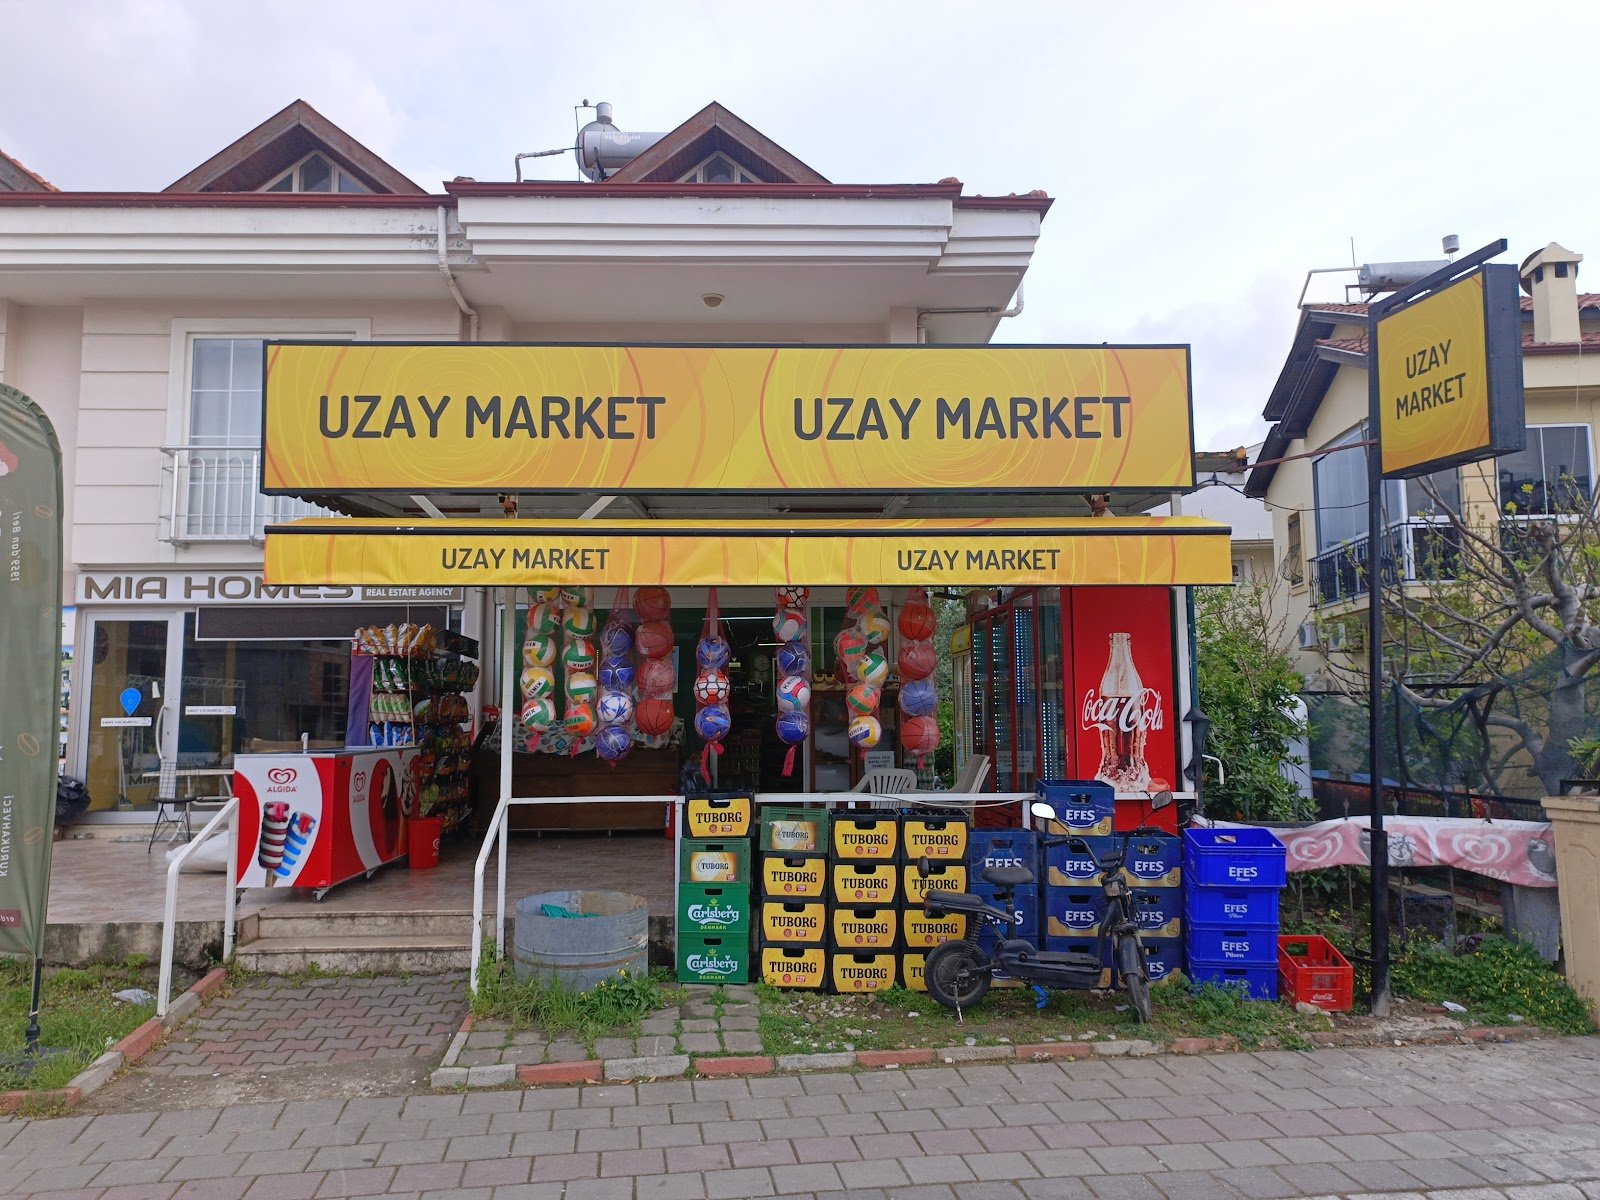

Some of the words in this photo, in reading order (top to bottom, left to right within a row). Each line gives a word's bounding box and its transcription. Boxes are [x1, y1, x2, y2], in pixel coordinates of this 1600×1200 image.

[1406, 339, 1451, 379] UZAY
[1396, 372, 1466, 420] MARKET
[319, 395, 451, 439] UZAY
[465, 395, 666, 440] MARKET
[794, 397, 921, 441] UZAY
[936, 396, 1131, 440] MARKET
[442, 547, 506, 569] UZAY
[512, 547, 610, 570] MARKET
[897, 549, 959, 571] UZAY
[966, 549, 1060, 570] MARKET
[85, 576, 167, 600] MIA
[366, 588, 386, 597] REAL
[388, 588, 416, 597] ESTATE
[418, 587, 453, 597] AGENCY
[1082, 688, 1163, 732] Coca-Cola
[696, 812, 742, 824] TUBORG
[1065, 809, 1096, 821] EFES
[781, 831, 809, 839] TUBORG
[842, 834, 888, 845] TUBORG
[912, 834, 958, 846] TUBORG
[701, 862, 729, 870] TUBORG
[1066, 860, 1095, 872] EFES
[1134, 860, 1164, 872] EFES
[1228, 866, 1258, 878] EFES
[771, 871, 817, 882] TUBORG
[842, 878, 888, 889] TUBORG
[912, 879, 958, 890] TUBORG
[688, 904, 740, 925] Carlsberg
[1224, 904, 1248, 913] EFES
[771, 916, 817, 928] TUBORG
[1065, 911, 1095, 922] EFES
[841, 923, 888, 934] TUBORG
[911, 923, 958, 934] TUBORG
[1221, 941, 1250, 951] EFES
[686, 954, 738, 975] Carlsberg
[769, 961, 817, 973] TUBORG
[840, 968, 887, 978] TUBORG
